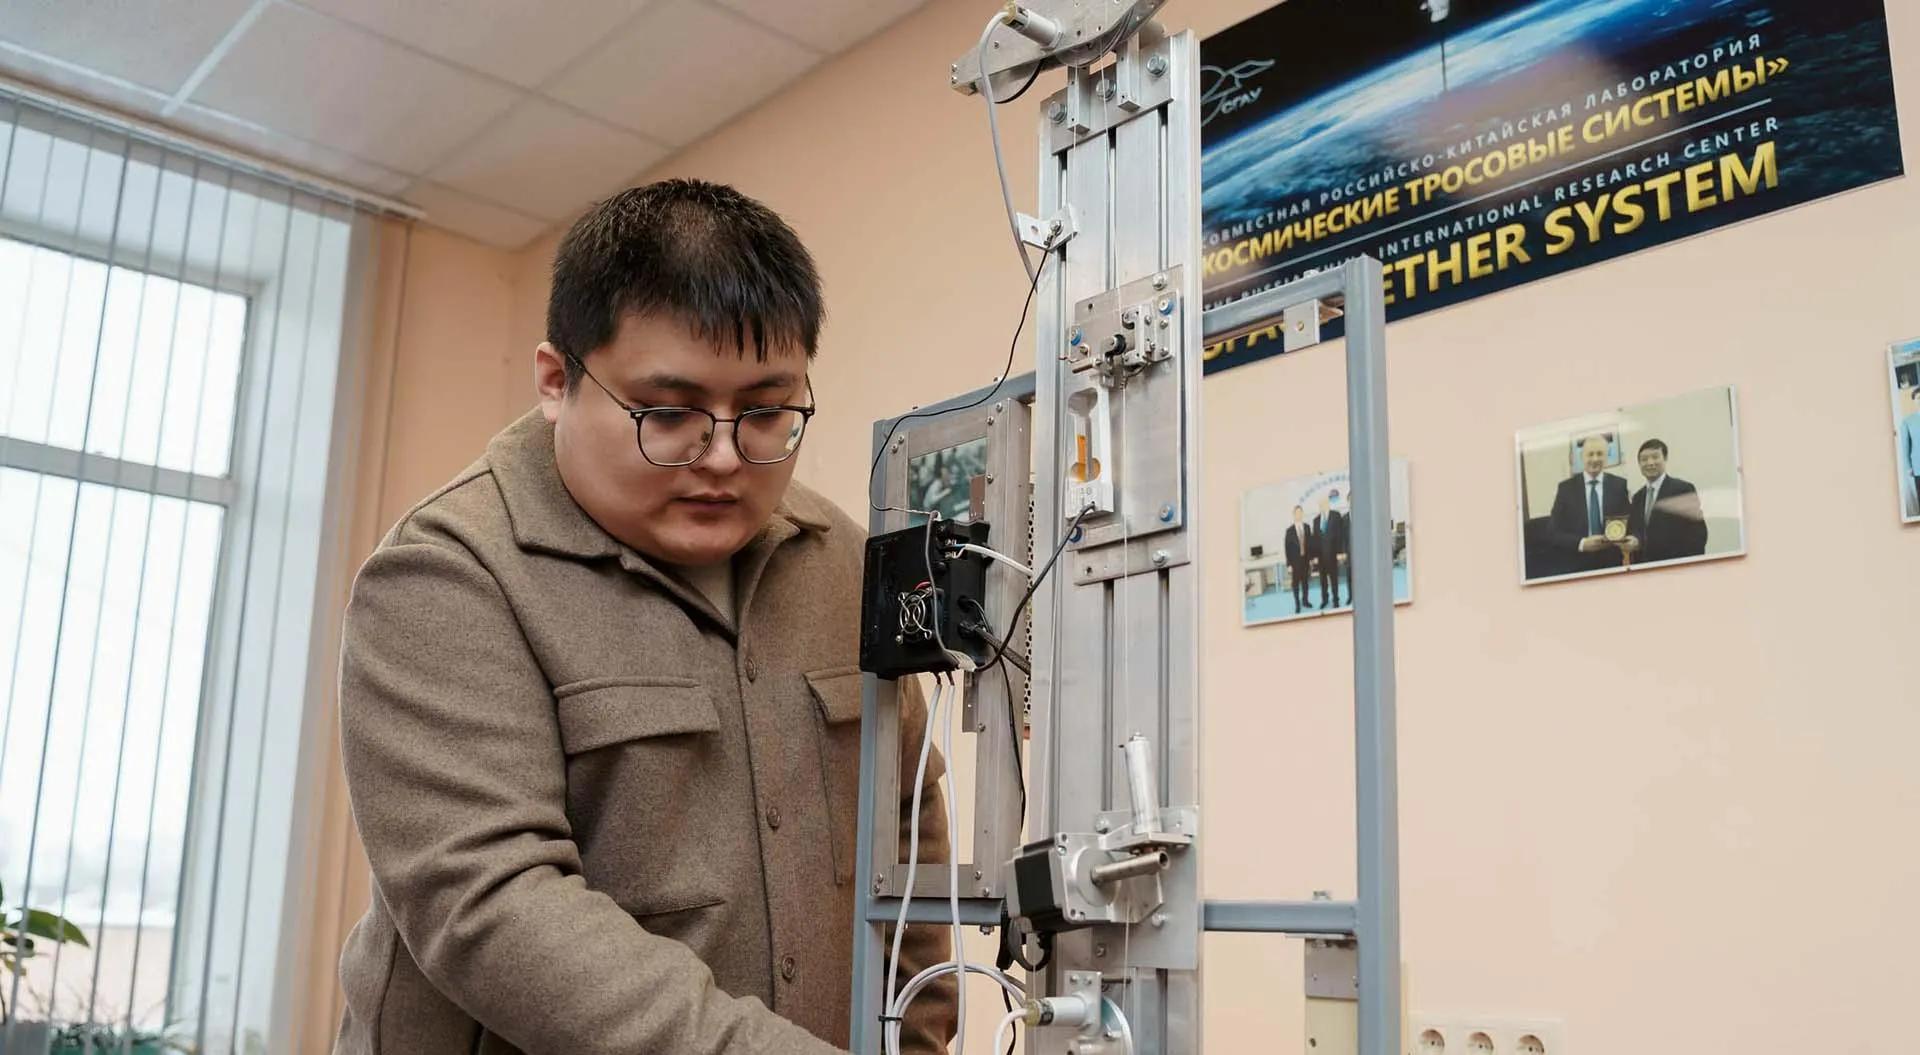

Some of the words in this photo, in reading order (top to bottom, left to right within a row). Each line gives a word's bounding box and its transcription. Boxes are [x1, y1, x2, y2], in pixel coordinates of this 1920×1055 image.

[1203, 186, 1400, 278] КОСМИЧЕСКИЕ
[1405, 124, 1575, 206] ТРОСОВЫЕ
[1582, 56, 1789, 144] СИСТЕМЫ»
[1320, 102, 1572, 205] РОССИЙСКО-КИТАЙСКАЯ
[1584, 33, 1761, 110] ЛАБОРАТОРИЯ
[1378, 194, 1542, 259] INTERNATIONAL
[1554, 152, 1670, 201] RESEARCH
[1684, 117, 1779, 159] CENTER
[1383, 223, 1532, 305] ETHER
[1544, 140, 1779, 255] SYSTEM
